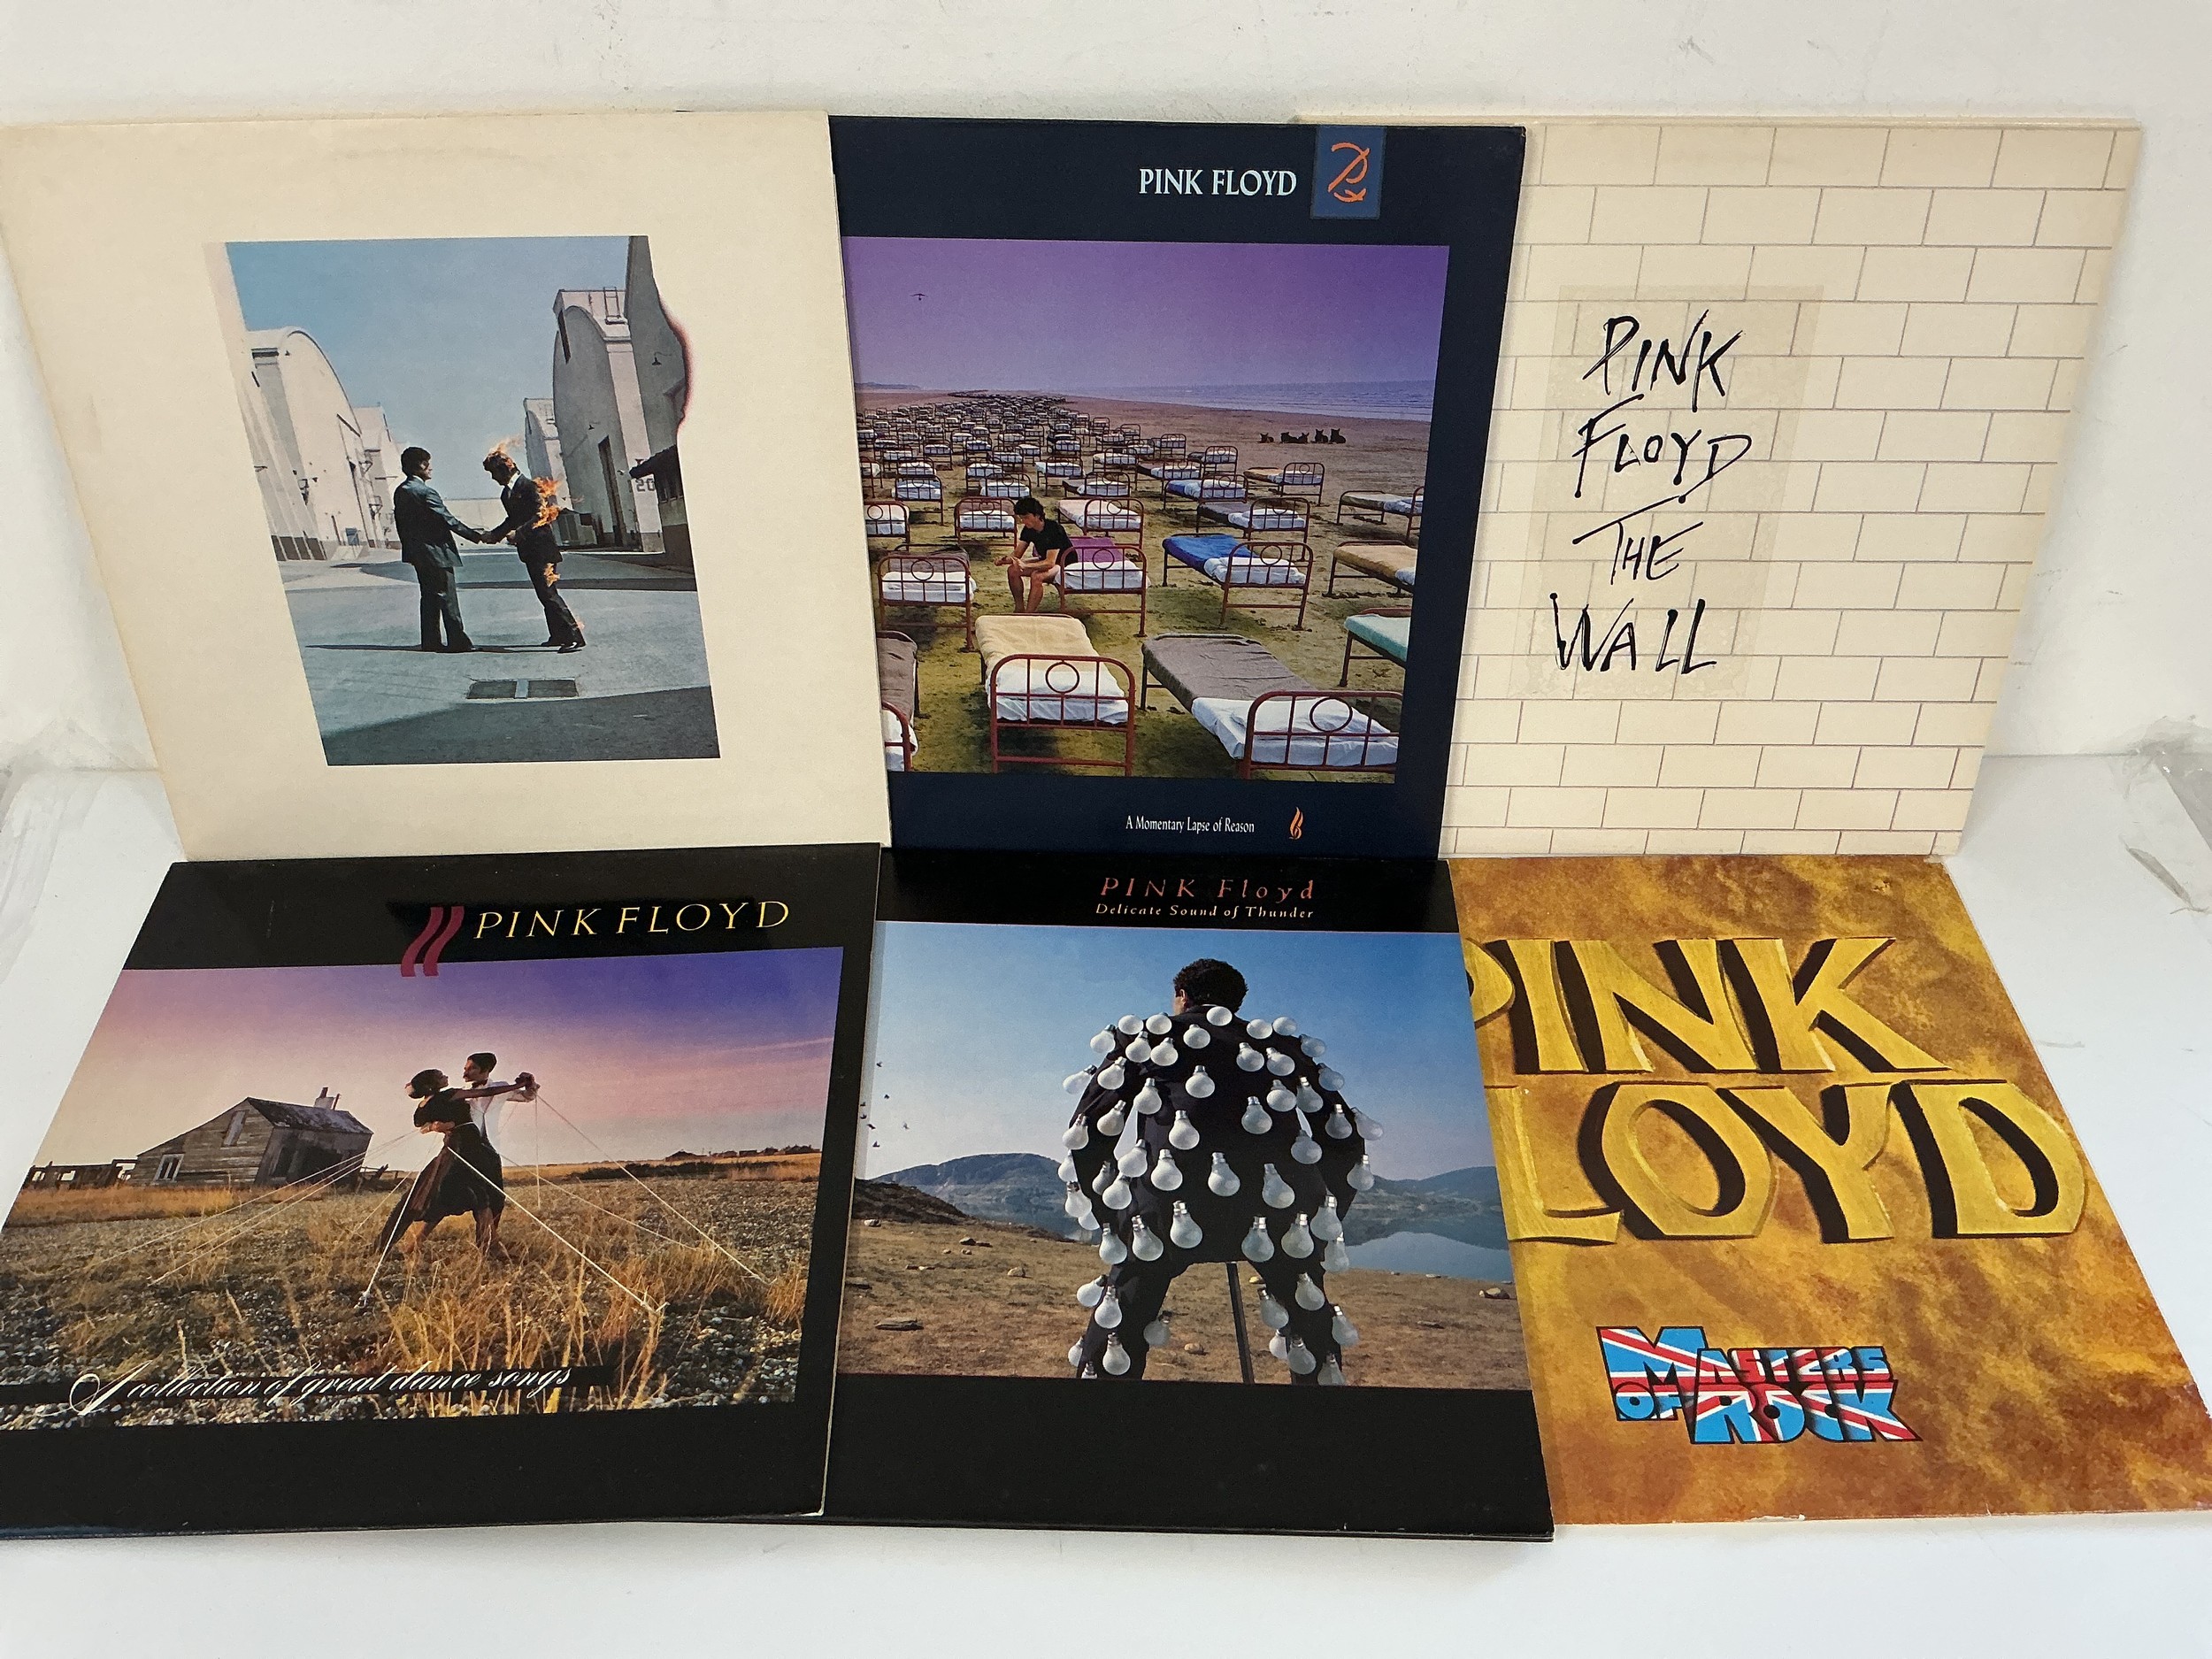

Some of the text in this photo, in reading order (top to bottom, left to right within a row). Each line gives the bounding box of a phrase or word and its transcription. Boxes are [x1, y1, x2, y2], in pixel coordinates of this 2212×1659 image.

[1139, 168, 1297, 196] PINK FLOYD
[1583, 310, 1743, 412] PINK
[1571, 394, 1752, 504] FLOYD
[1572, 495, 1704, 585] THE
[1549, 593, 1717, 674] WALL
[1125, 815, 1256, 834] A Momentary Lapse of Reason
[1095, 903, 1314, 919] Delicate Sound of Thunder
[1100, 877, 1314, 903] PINK Floyd
[473, 901, 789, 940] PINK FLOYD
[1484, 1079, 2085, 1245] LOYD
[389, 1361, 483, 1392] dance
[1596, 1326, 1894, 1386] MASTERS
[127, 1366, 262, 1398] collection
[263, 1362, 322, 1407] of
[289, 1365, 398, 1407] great
[488, 1368, 572, 1399] songs
[1612, 1379, 1923, 1444] OF ROCK
